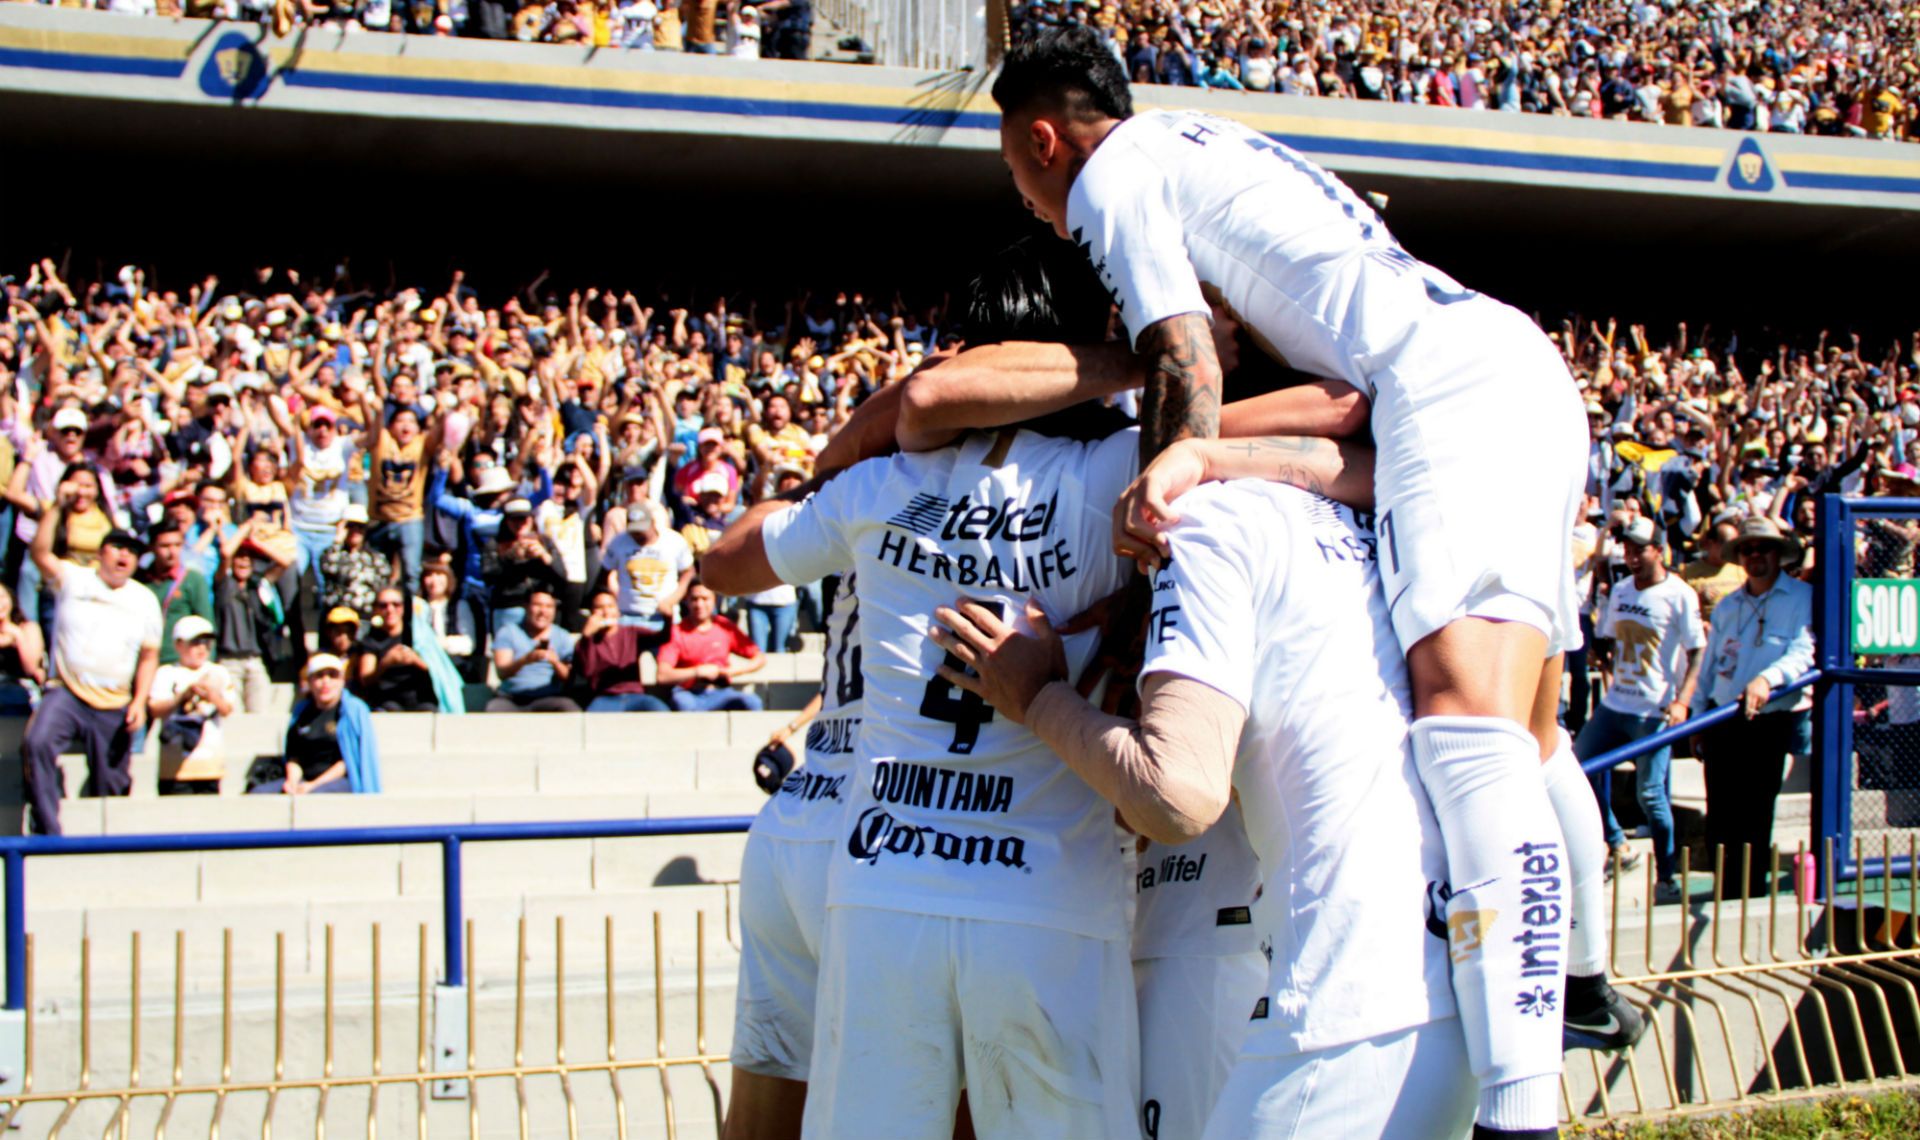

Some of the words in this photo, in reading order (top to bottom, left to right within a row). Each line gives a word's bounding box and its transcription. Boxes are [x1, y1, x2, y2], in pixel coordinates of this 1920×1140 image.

[940, 489, 1058, 541] telcel
[878, 530, 1077, 593] HERBALIFE
[1857, 584, 1918, 648] SOLO
[919, 597, 1002, 755] 4
[872, 761, 1014, 813] QUINTANA
[848, 806, 1027, 866] Corona
